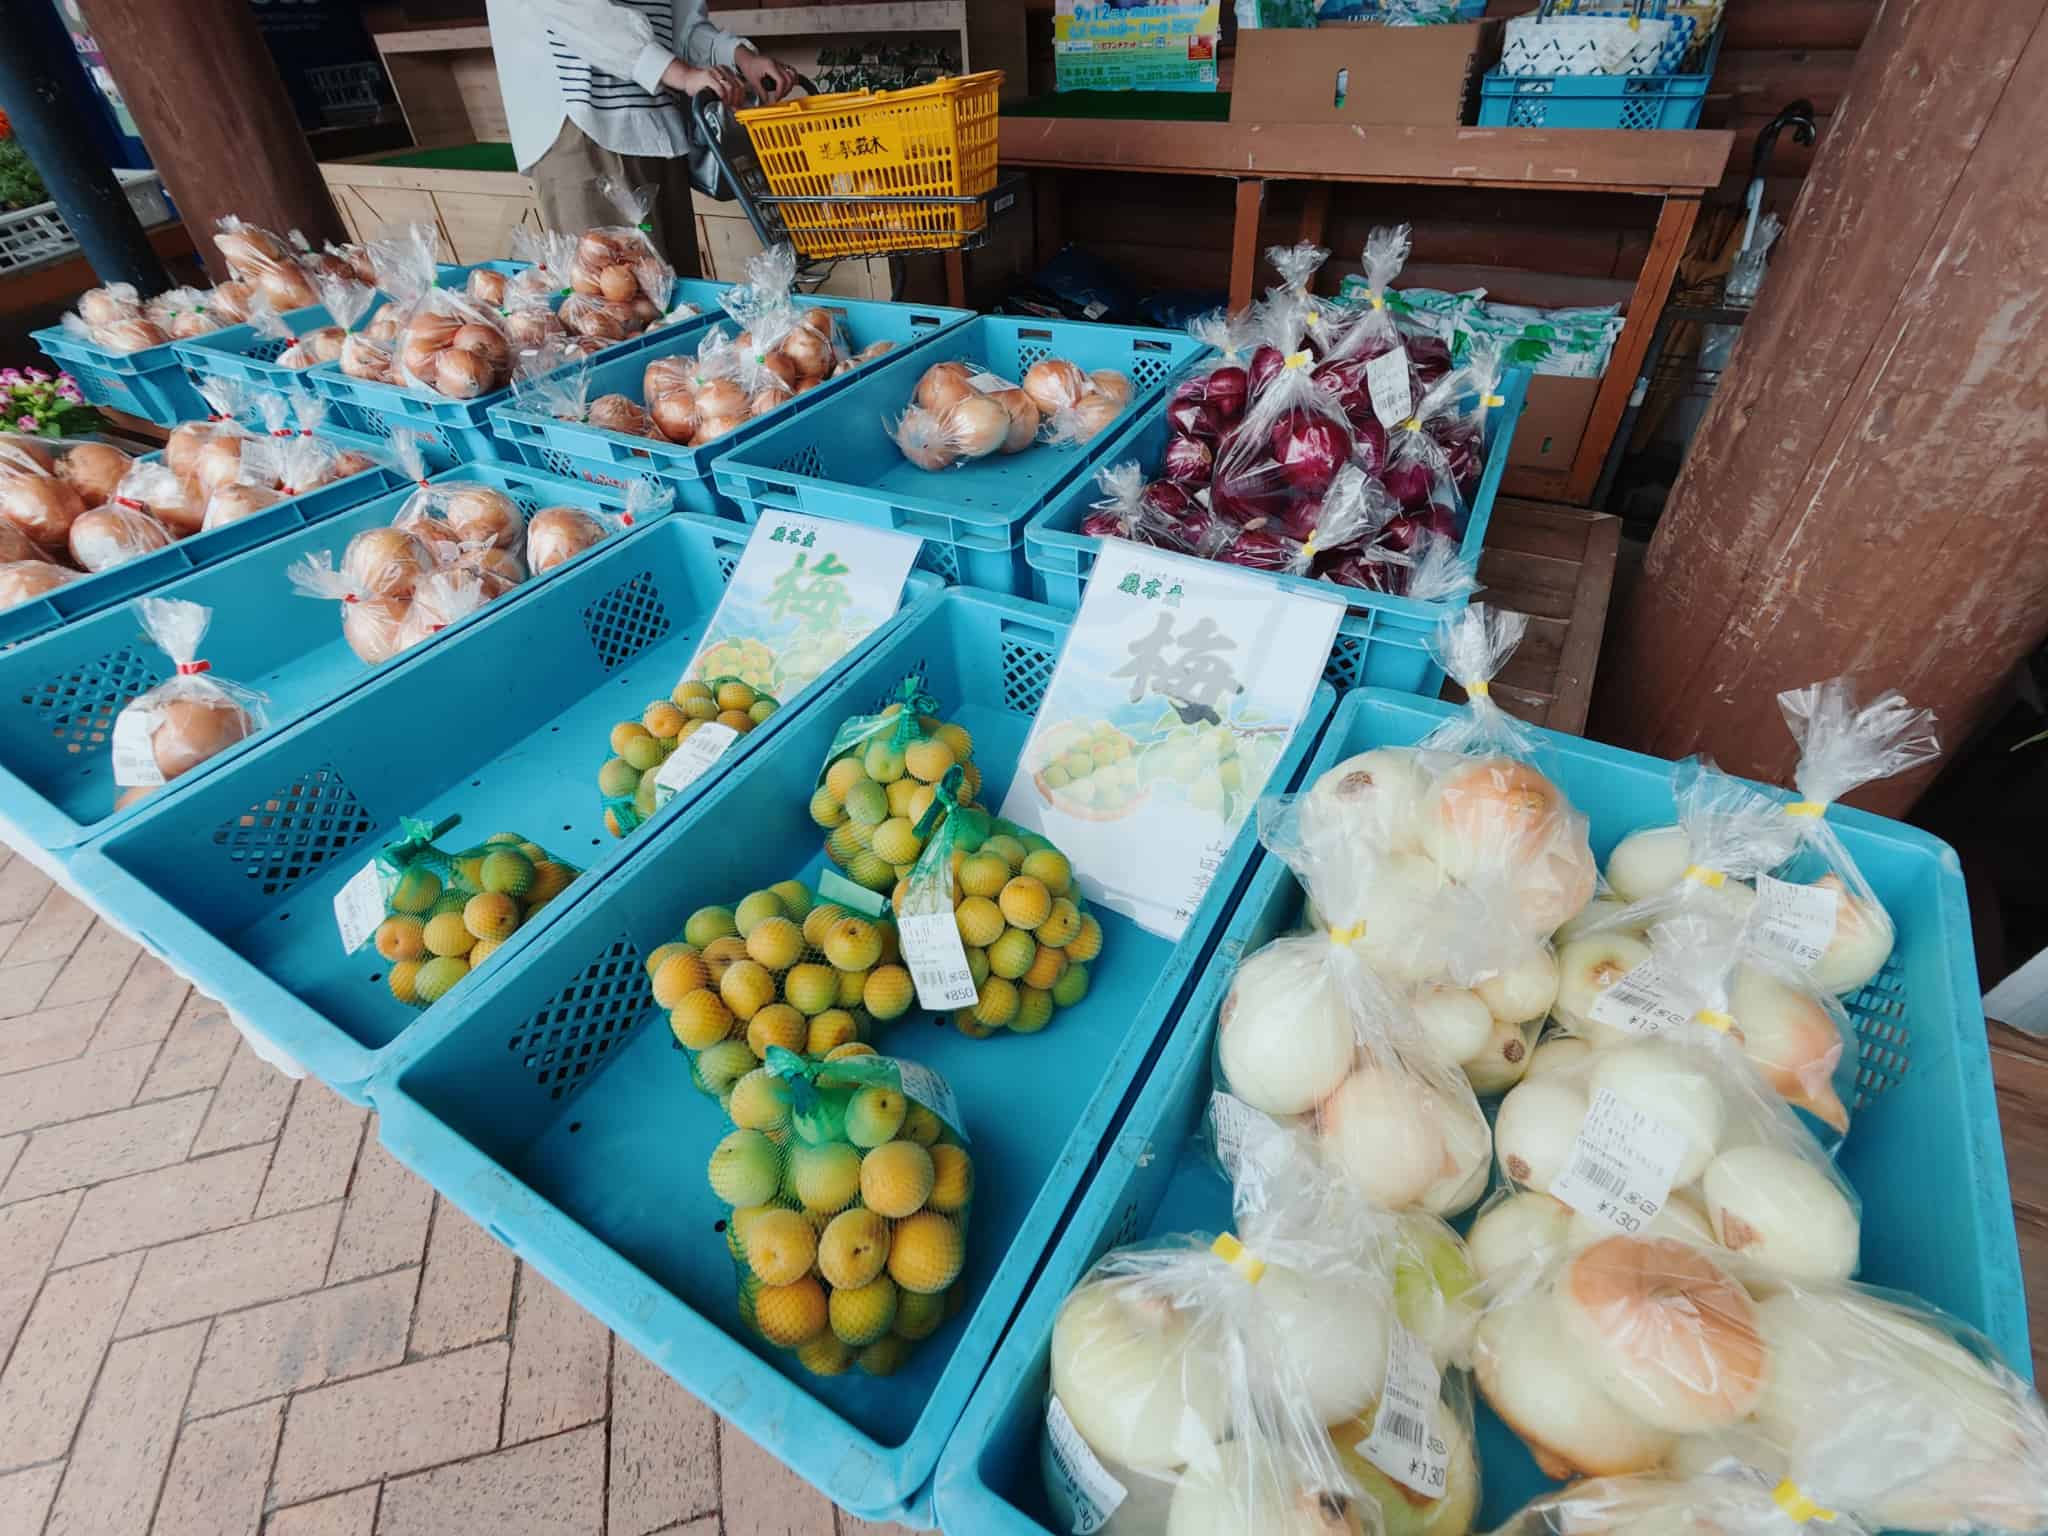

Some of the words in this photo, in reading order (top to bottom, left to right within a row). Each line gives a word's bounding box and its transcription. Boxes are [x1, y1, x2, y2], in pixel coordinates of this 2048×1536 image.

[763, 552, 852, 633] 梅
[1110, 611, 1245, 726] 梅
[945, 987, 974, 1001] ¥850
[1597, 1199, 1641, 1233] ¥130
[1409, 1457, 1446, 1487] ¥130
